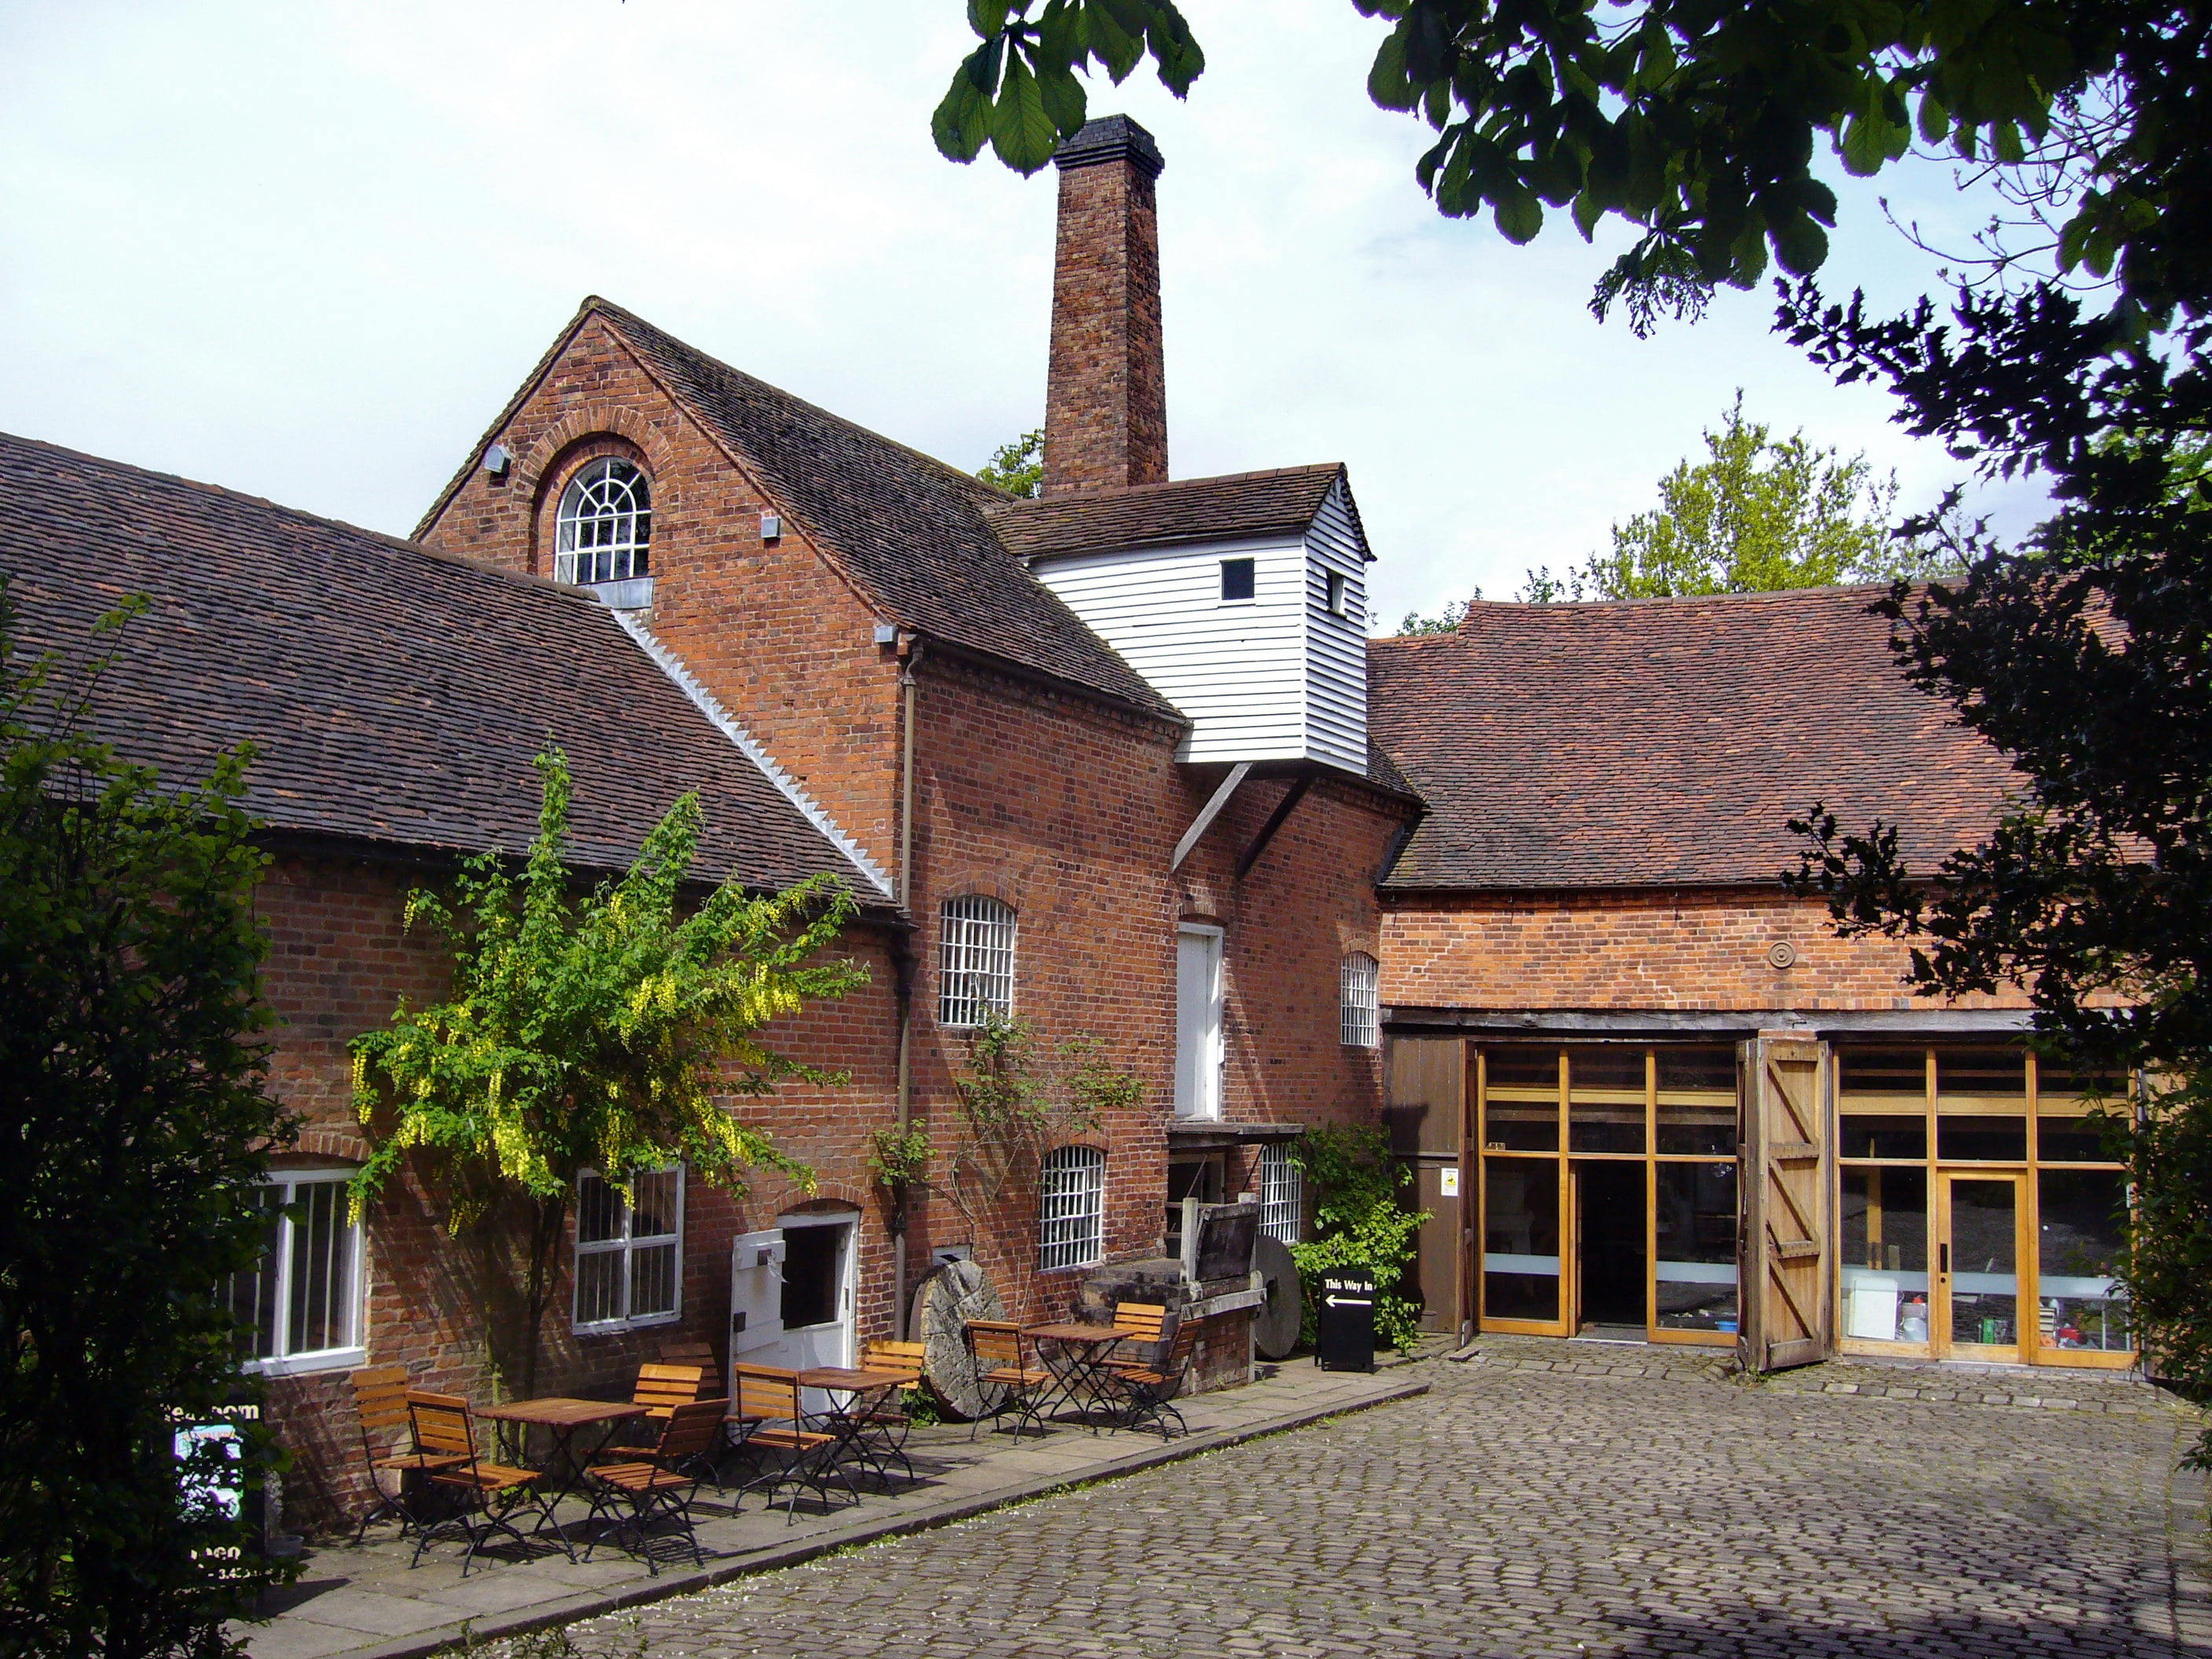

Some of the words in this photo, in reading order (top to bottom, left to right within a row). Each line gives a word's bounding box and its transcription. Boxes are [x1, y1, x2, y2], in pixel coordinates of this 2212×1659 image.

[1325, 1279, 1342, 1289] This
[1344, 1280, 1362, 1293] Way
[1364, 1281, 1373, 1291] In
[159, 1403, 259, 1422] eaoom
